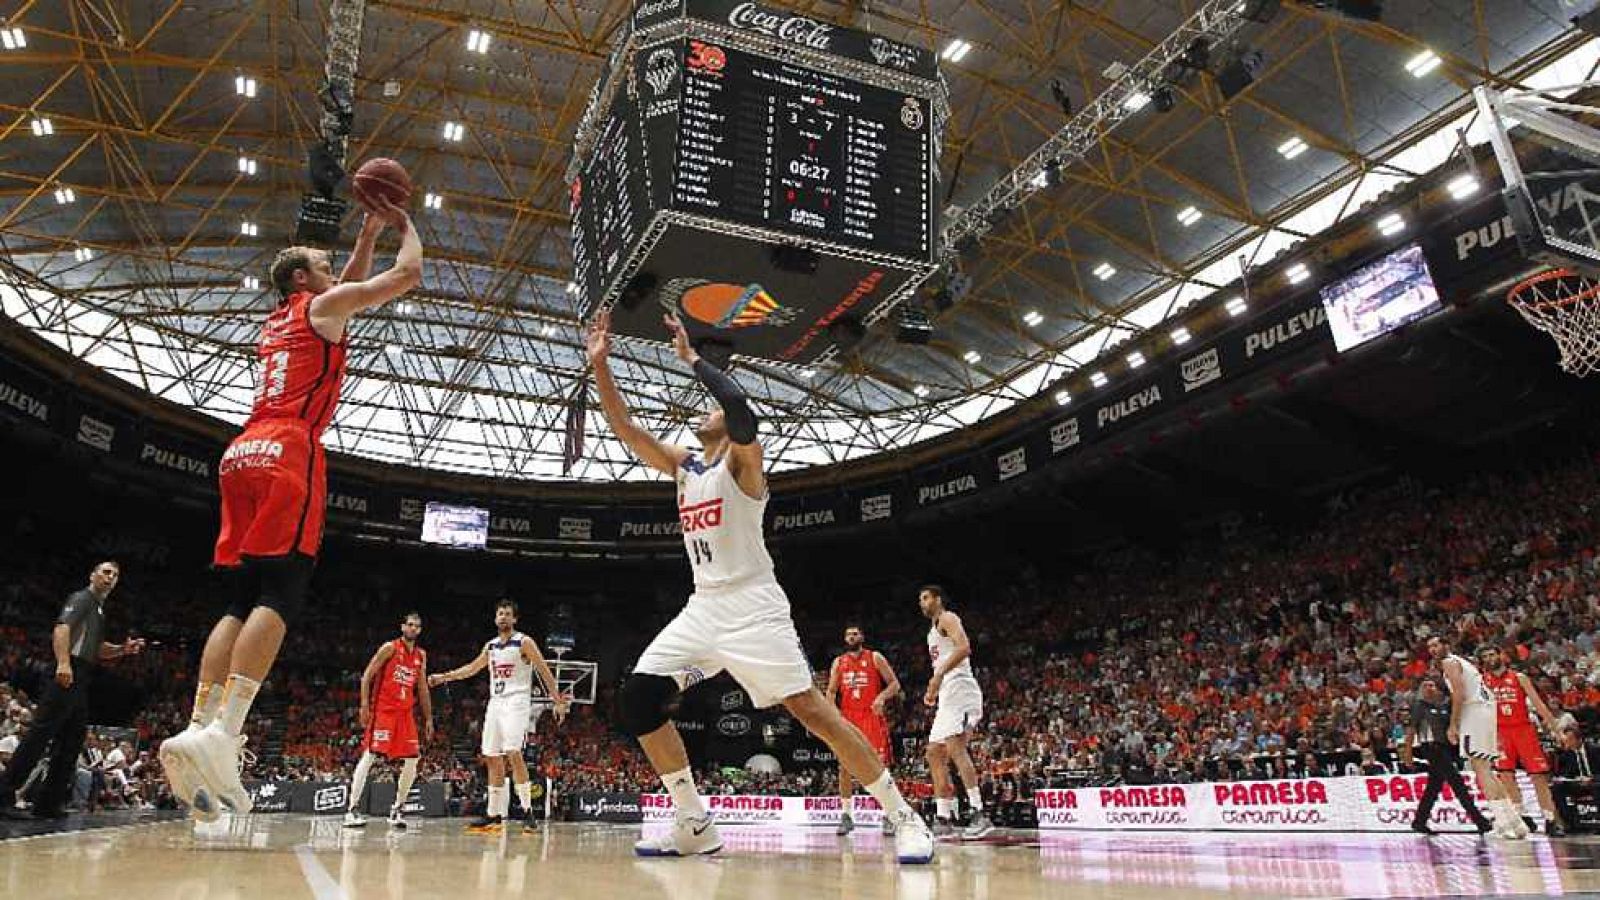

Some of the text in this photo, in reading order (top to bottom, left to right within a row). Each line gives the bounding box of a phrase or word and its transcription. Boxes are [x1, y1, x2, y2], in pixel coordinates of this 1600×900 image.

[788, 112, 834, 132] 3 7
[789, 159, 830, 181] 06:27
[0, 382, 49, 422] ULEVA
[1097, 384, 1162, 428] PULEVA
[141, 443, 209, 478] PULEVA
[918, 473, 977, 504] PULEVA
[327, 493, 367, 513] LEVA
[490, 516, 530, 533] LEVA
[774, 508, 836, 530] PULEVA
[693, 538, 712, 565] 14
[709, 796, 783, 811] PAMESA
[1034, 789, 1078, 809] MESA
[1100, 785, 1186, 808] PAMESA
[1214, 780, 1328, 806] PAMESA
